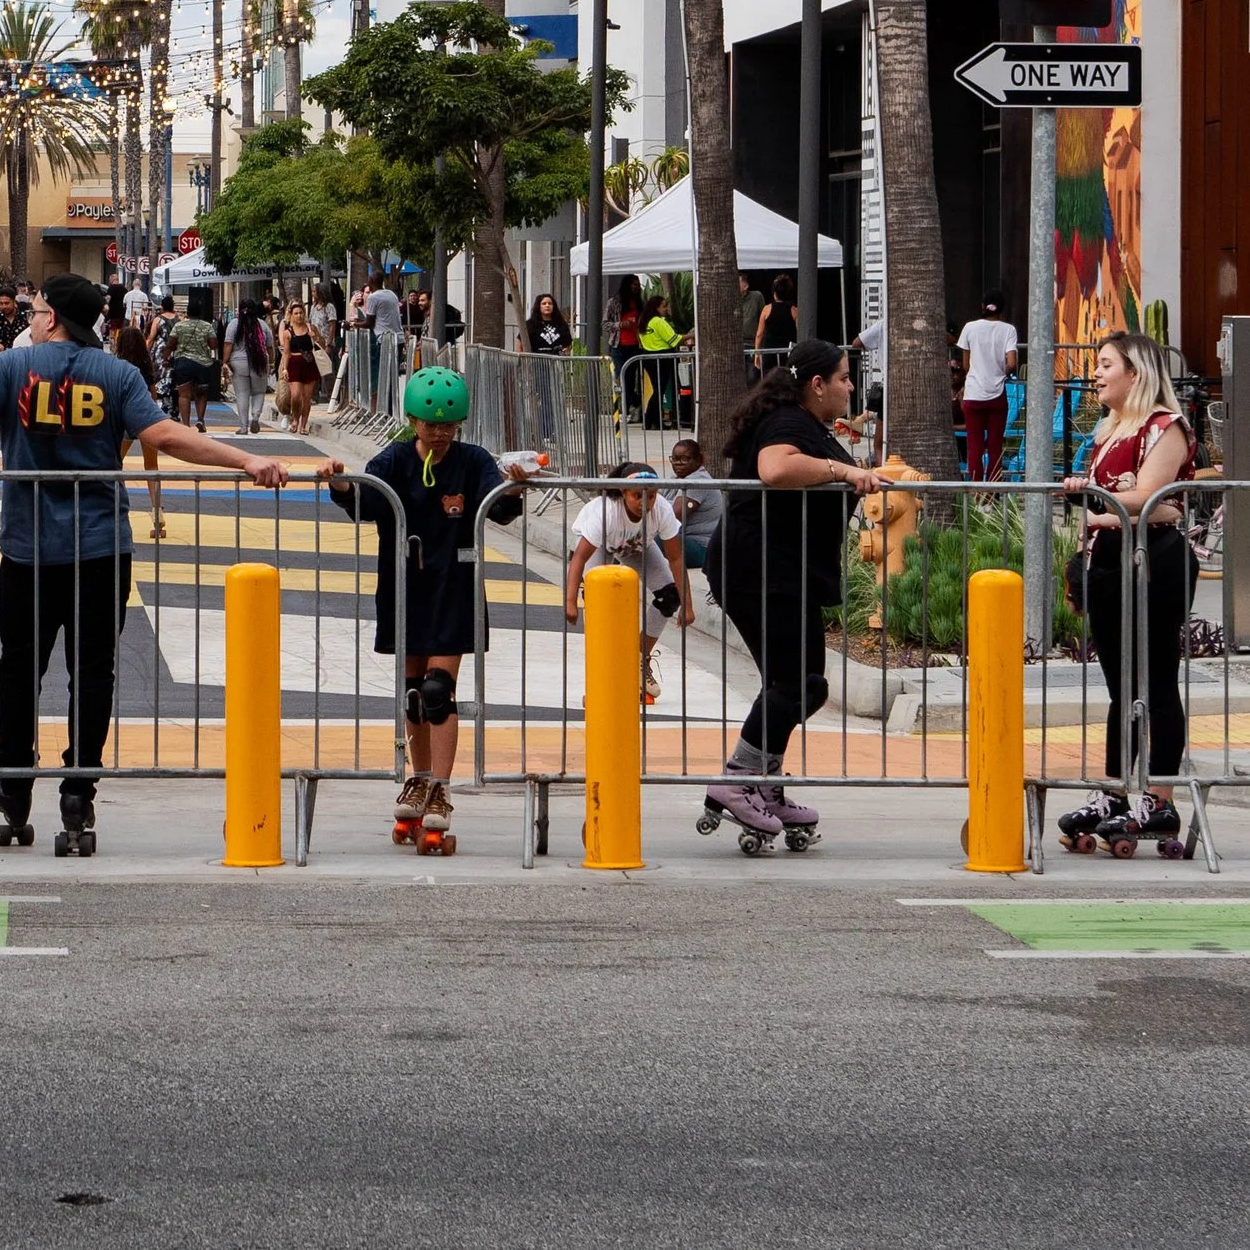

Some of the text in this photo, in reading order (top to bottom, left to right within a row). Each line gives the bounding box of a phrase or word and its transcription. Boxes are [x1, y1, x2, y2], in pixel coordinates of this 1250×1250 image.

[1010, 64, 1122, 87] ONE WAY
[180, 237, 204, 249] STO
[107, 249, 116, 258] ST
[36, 381, 105, 427] LB
